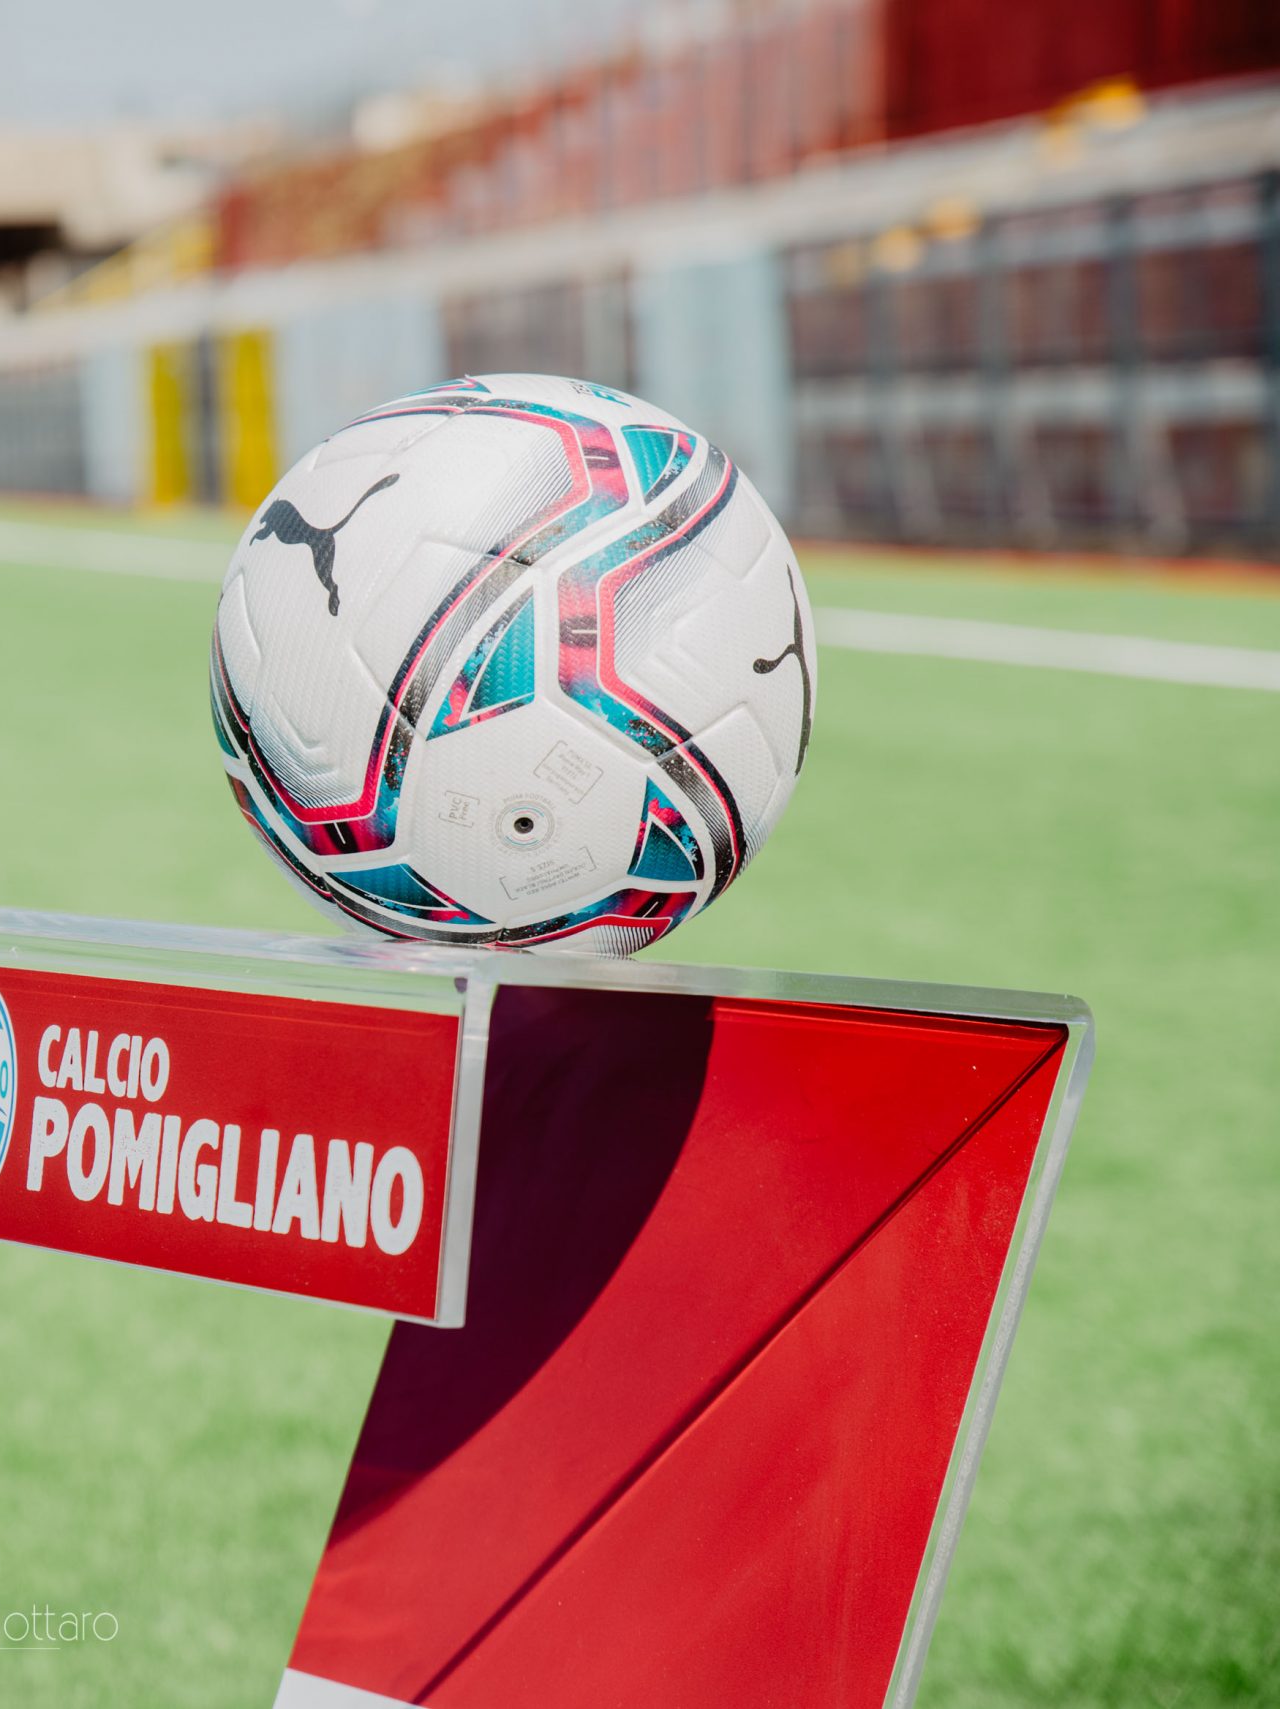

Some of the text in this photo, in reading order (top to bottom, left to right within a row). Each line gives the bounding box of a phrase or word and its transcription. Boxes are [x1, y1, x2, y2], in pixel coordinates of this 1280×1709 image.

[449, 797, 462, 819] PVC
[38, 1025, 170, 1102] CALCIO
[26, 1096, 424, 1255] POMIGLIANO
